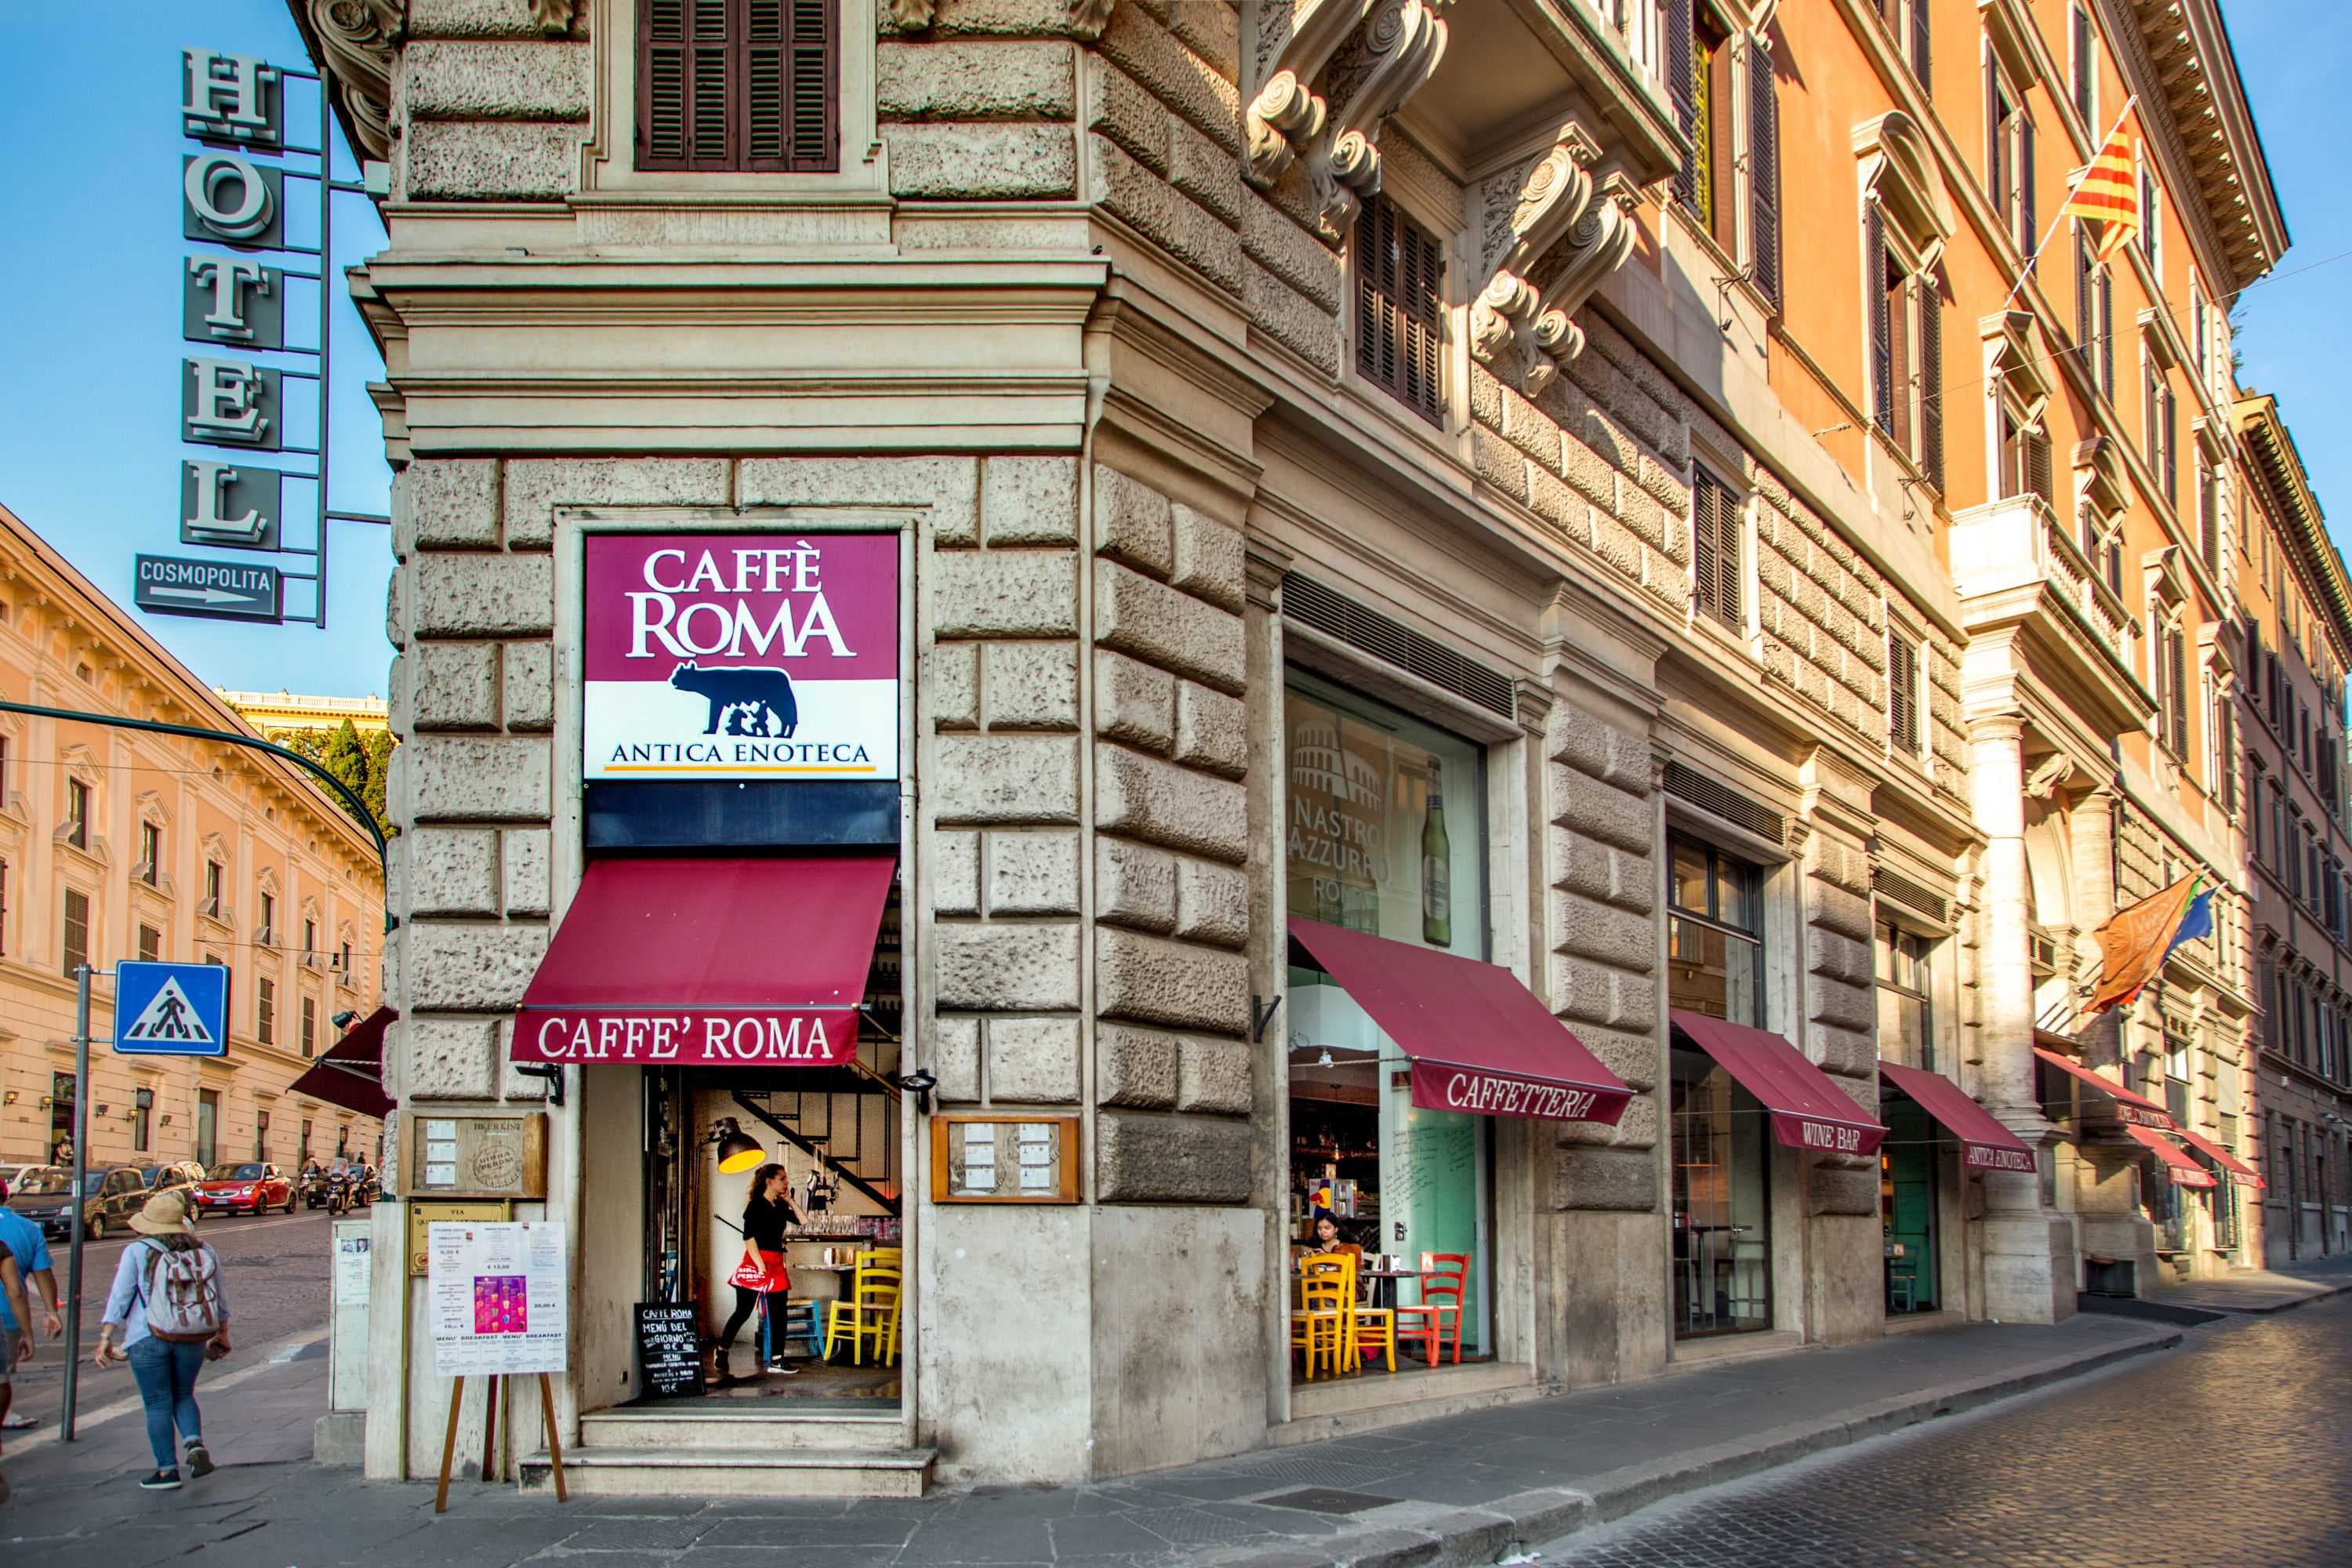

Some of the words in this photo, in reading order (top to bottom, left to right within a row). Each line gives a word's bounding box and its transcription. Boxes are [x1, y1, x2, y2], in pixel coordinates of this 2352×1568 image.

[181, 45, 276, 543] HOTEL
[140, 561, 271, 592] COSMOPOLITA
[643, 539, 822, 593] CAFFÈ
[624, 591, 858, 659] ROMA
[611, 742, 723, 763] ANTICA
[735, 742, 871, 763] ENOTECA
[1294, 794, 1381, 849] NASTRO
[538, 1016, 691, 1059] CAFFE'
[702, 1017, 833, 1060] ROMA
[1446, 1073, 1597, 1118] CAFFETTERIA
[1802, 1121, 1835, 1148] WINE
[1837, 1127, 1860, 1152] BAR
[1968, 1145, 1994, 1167] ANTICA
[1995, 1149, 2033, 1170] ENOTECA
[670, 1309, 693, 1319] ROMA
[670, 1322, 688, 1332] DEL
[654, 1334, 684, 1344] GIORNO
